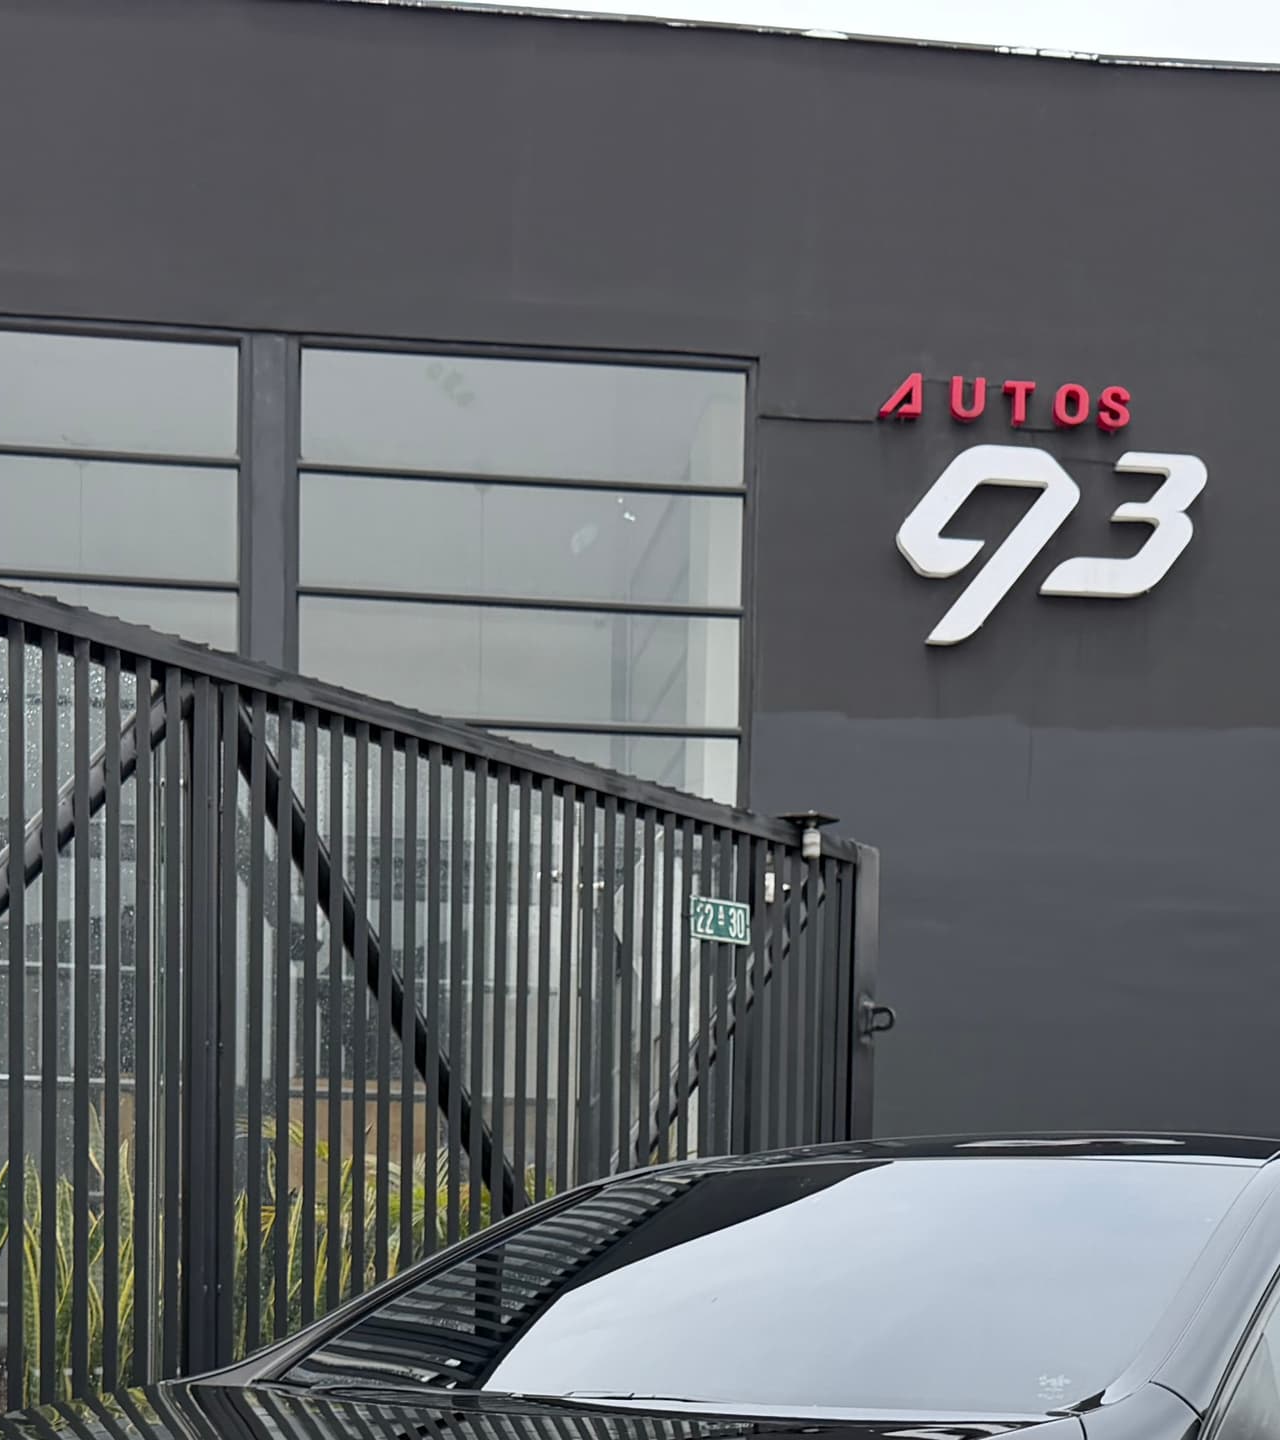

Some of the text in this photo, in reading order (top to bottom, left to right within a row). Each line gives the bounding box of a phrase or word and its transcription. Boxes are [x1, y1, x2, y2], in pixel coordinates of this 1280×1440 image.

[877, 373, 1132, 432] AUTOS
[896, 444, 1208, 646] 93
[696, 902, 714, 935] 22
[729, 907, 745, 938] 30
